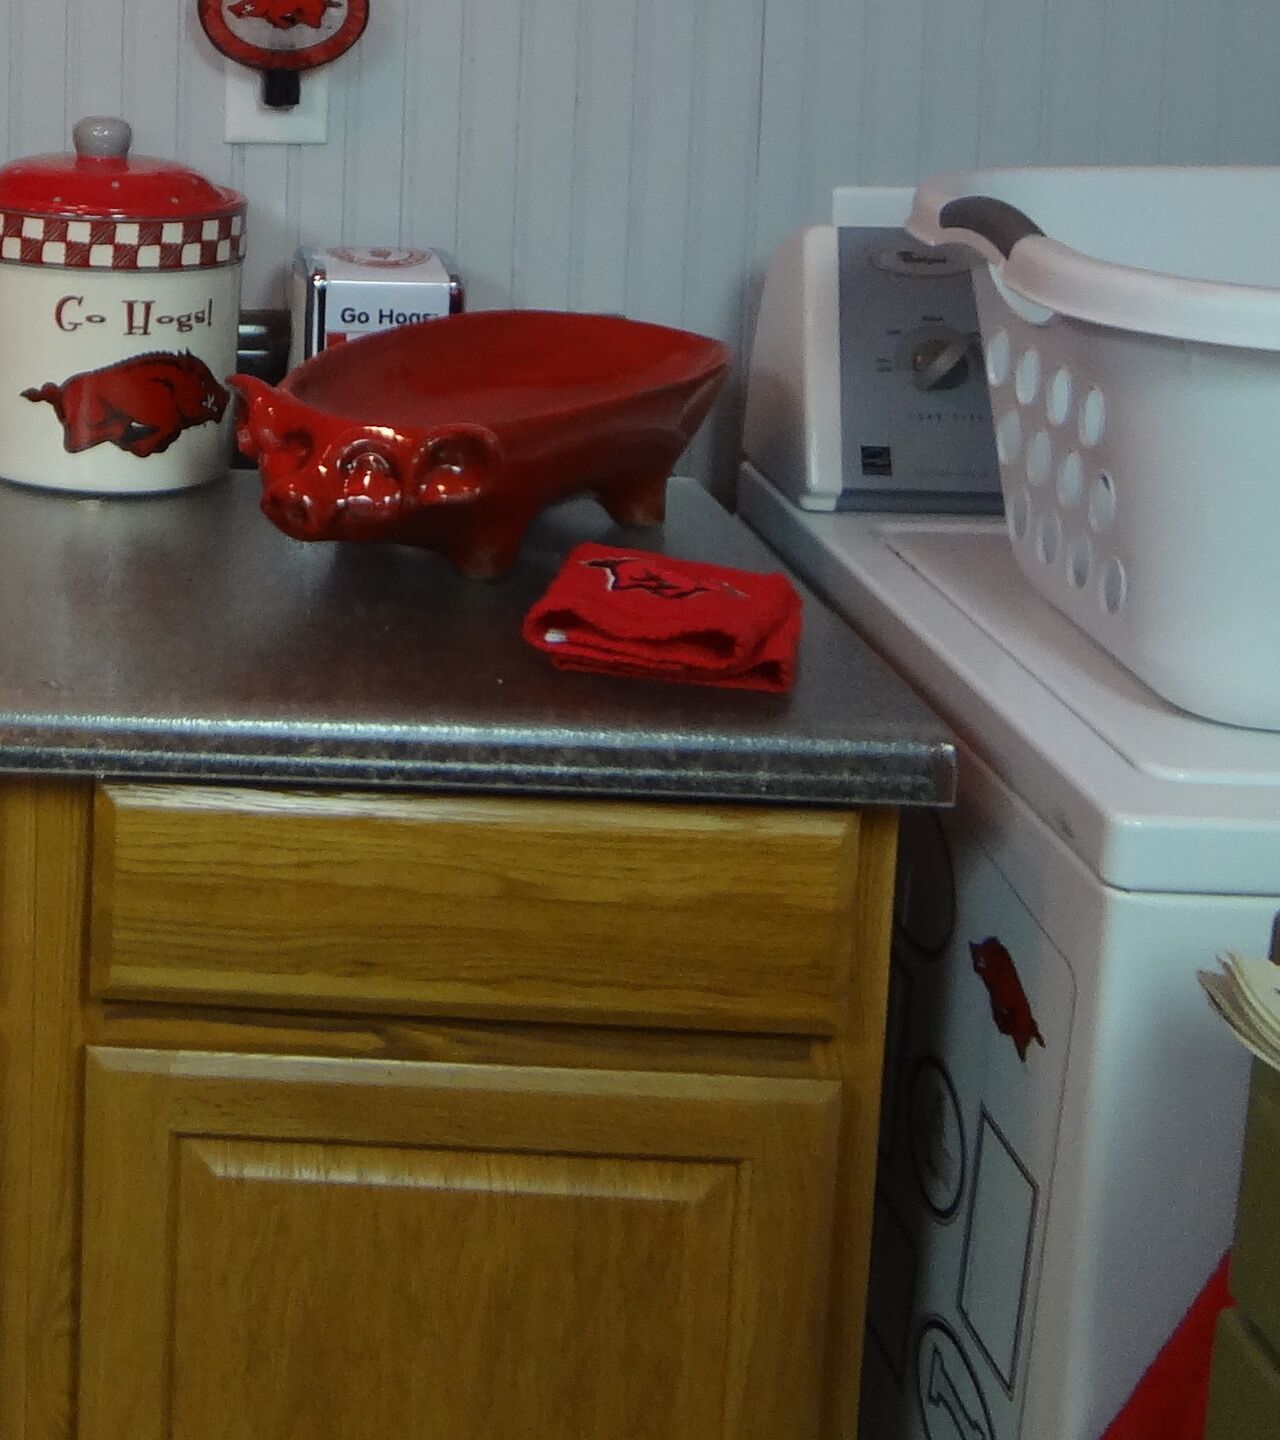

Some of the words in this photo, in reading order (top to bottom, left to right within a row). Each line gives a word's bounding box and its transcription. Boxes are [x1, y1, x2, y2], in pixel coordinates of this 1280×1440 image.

[54, 294, 106, 333] Go
[121, 297, 213, 336] Hogs!
[340, 306, 370, 325] Go
